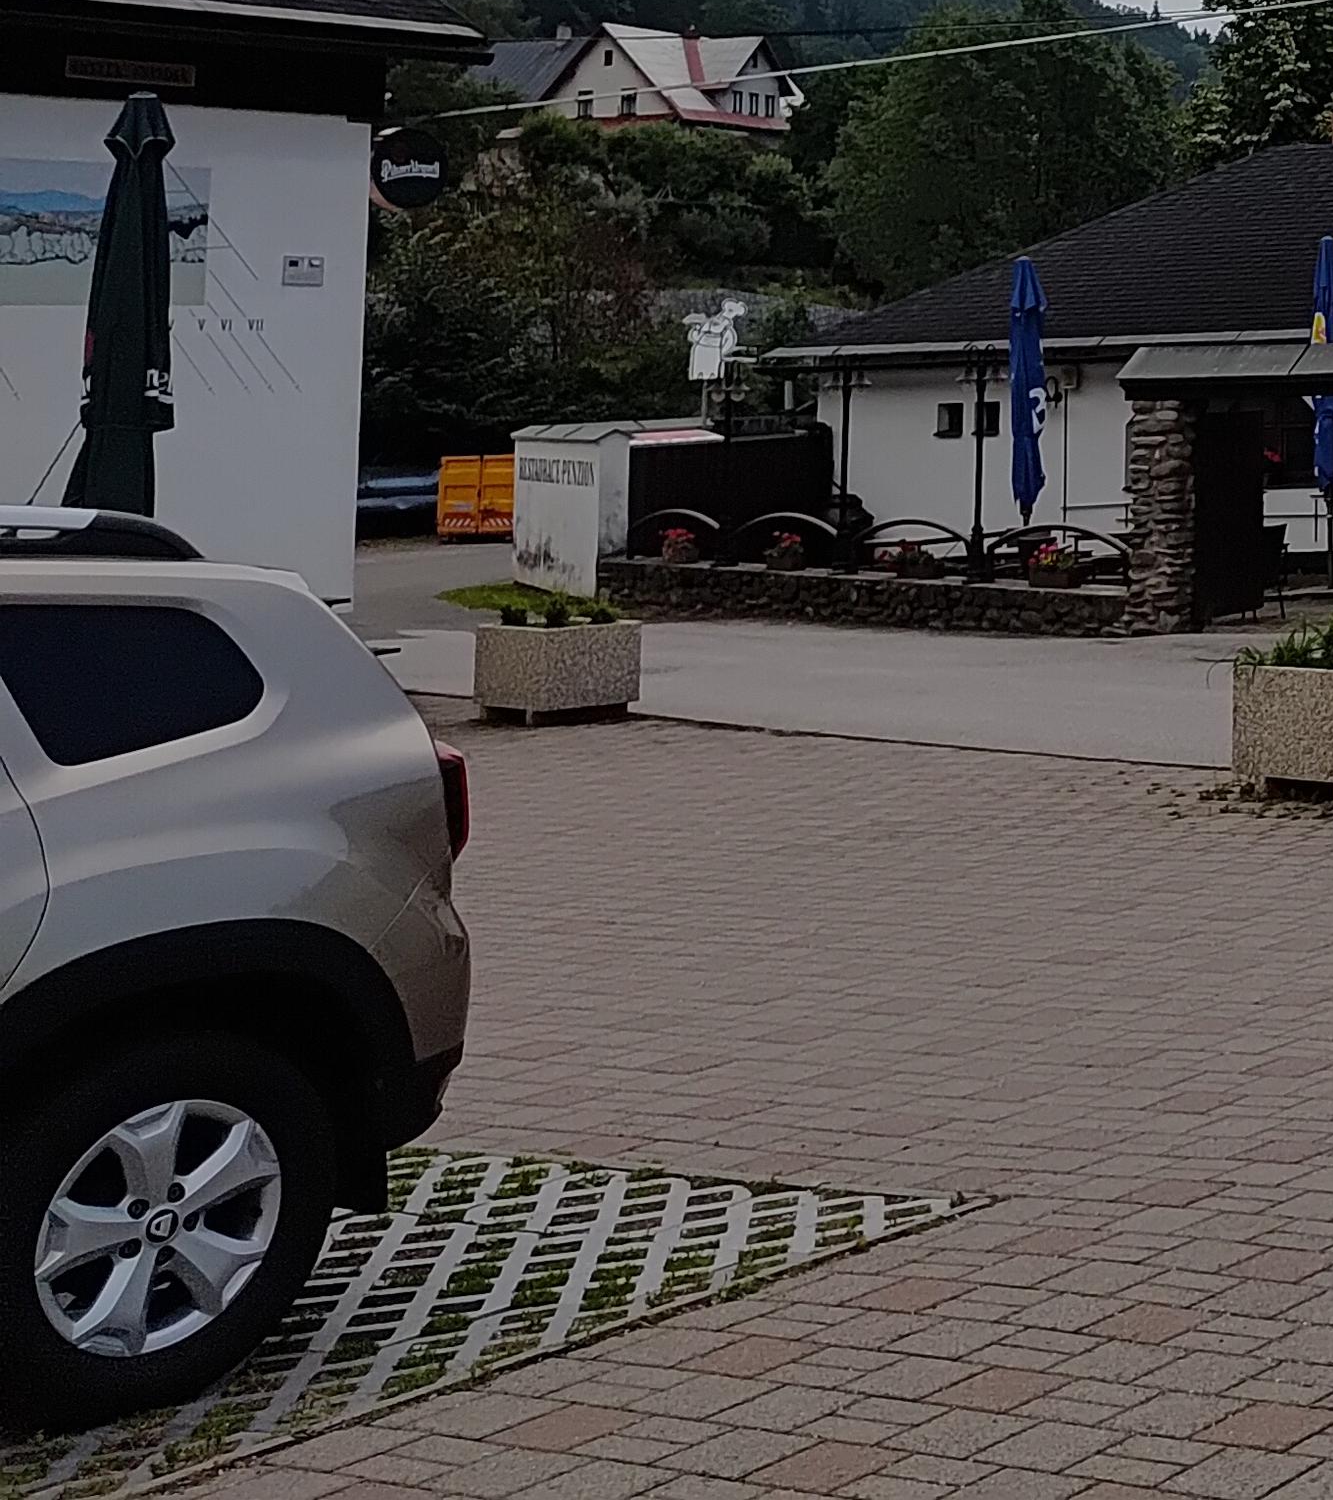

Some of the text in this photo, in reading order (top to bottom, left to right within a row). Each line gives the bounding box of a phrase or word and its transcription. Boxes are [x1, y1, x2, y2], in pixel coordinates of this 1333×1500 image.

[221, 319, 232, 331] VI
[248, 319, 264, 332] VII
[519, 457, 595, 487] RESTAURACE PENZION
